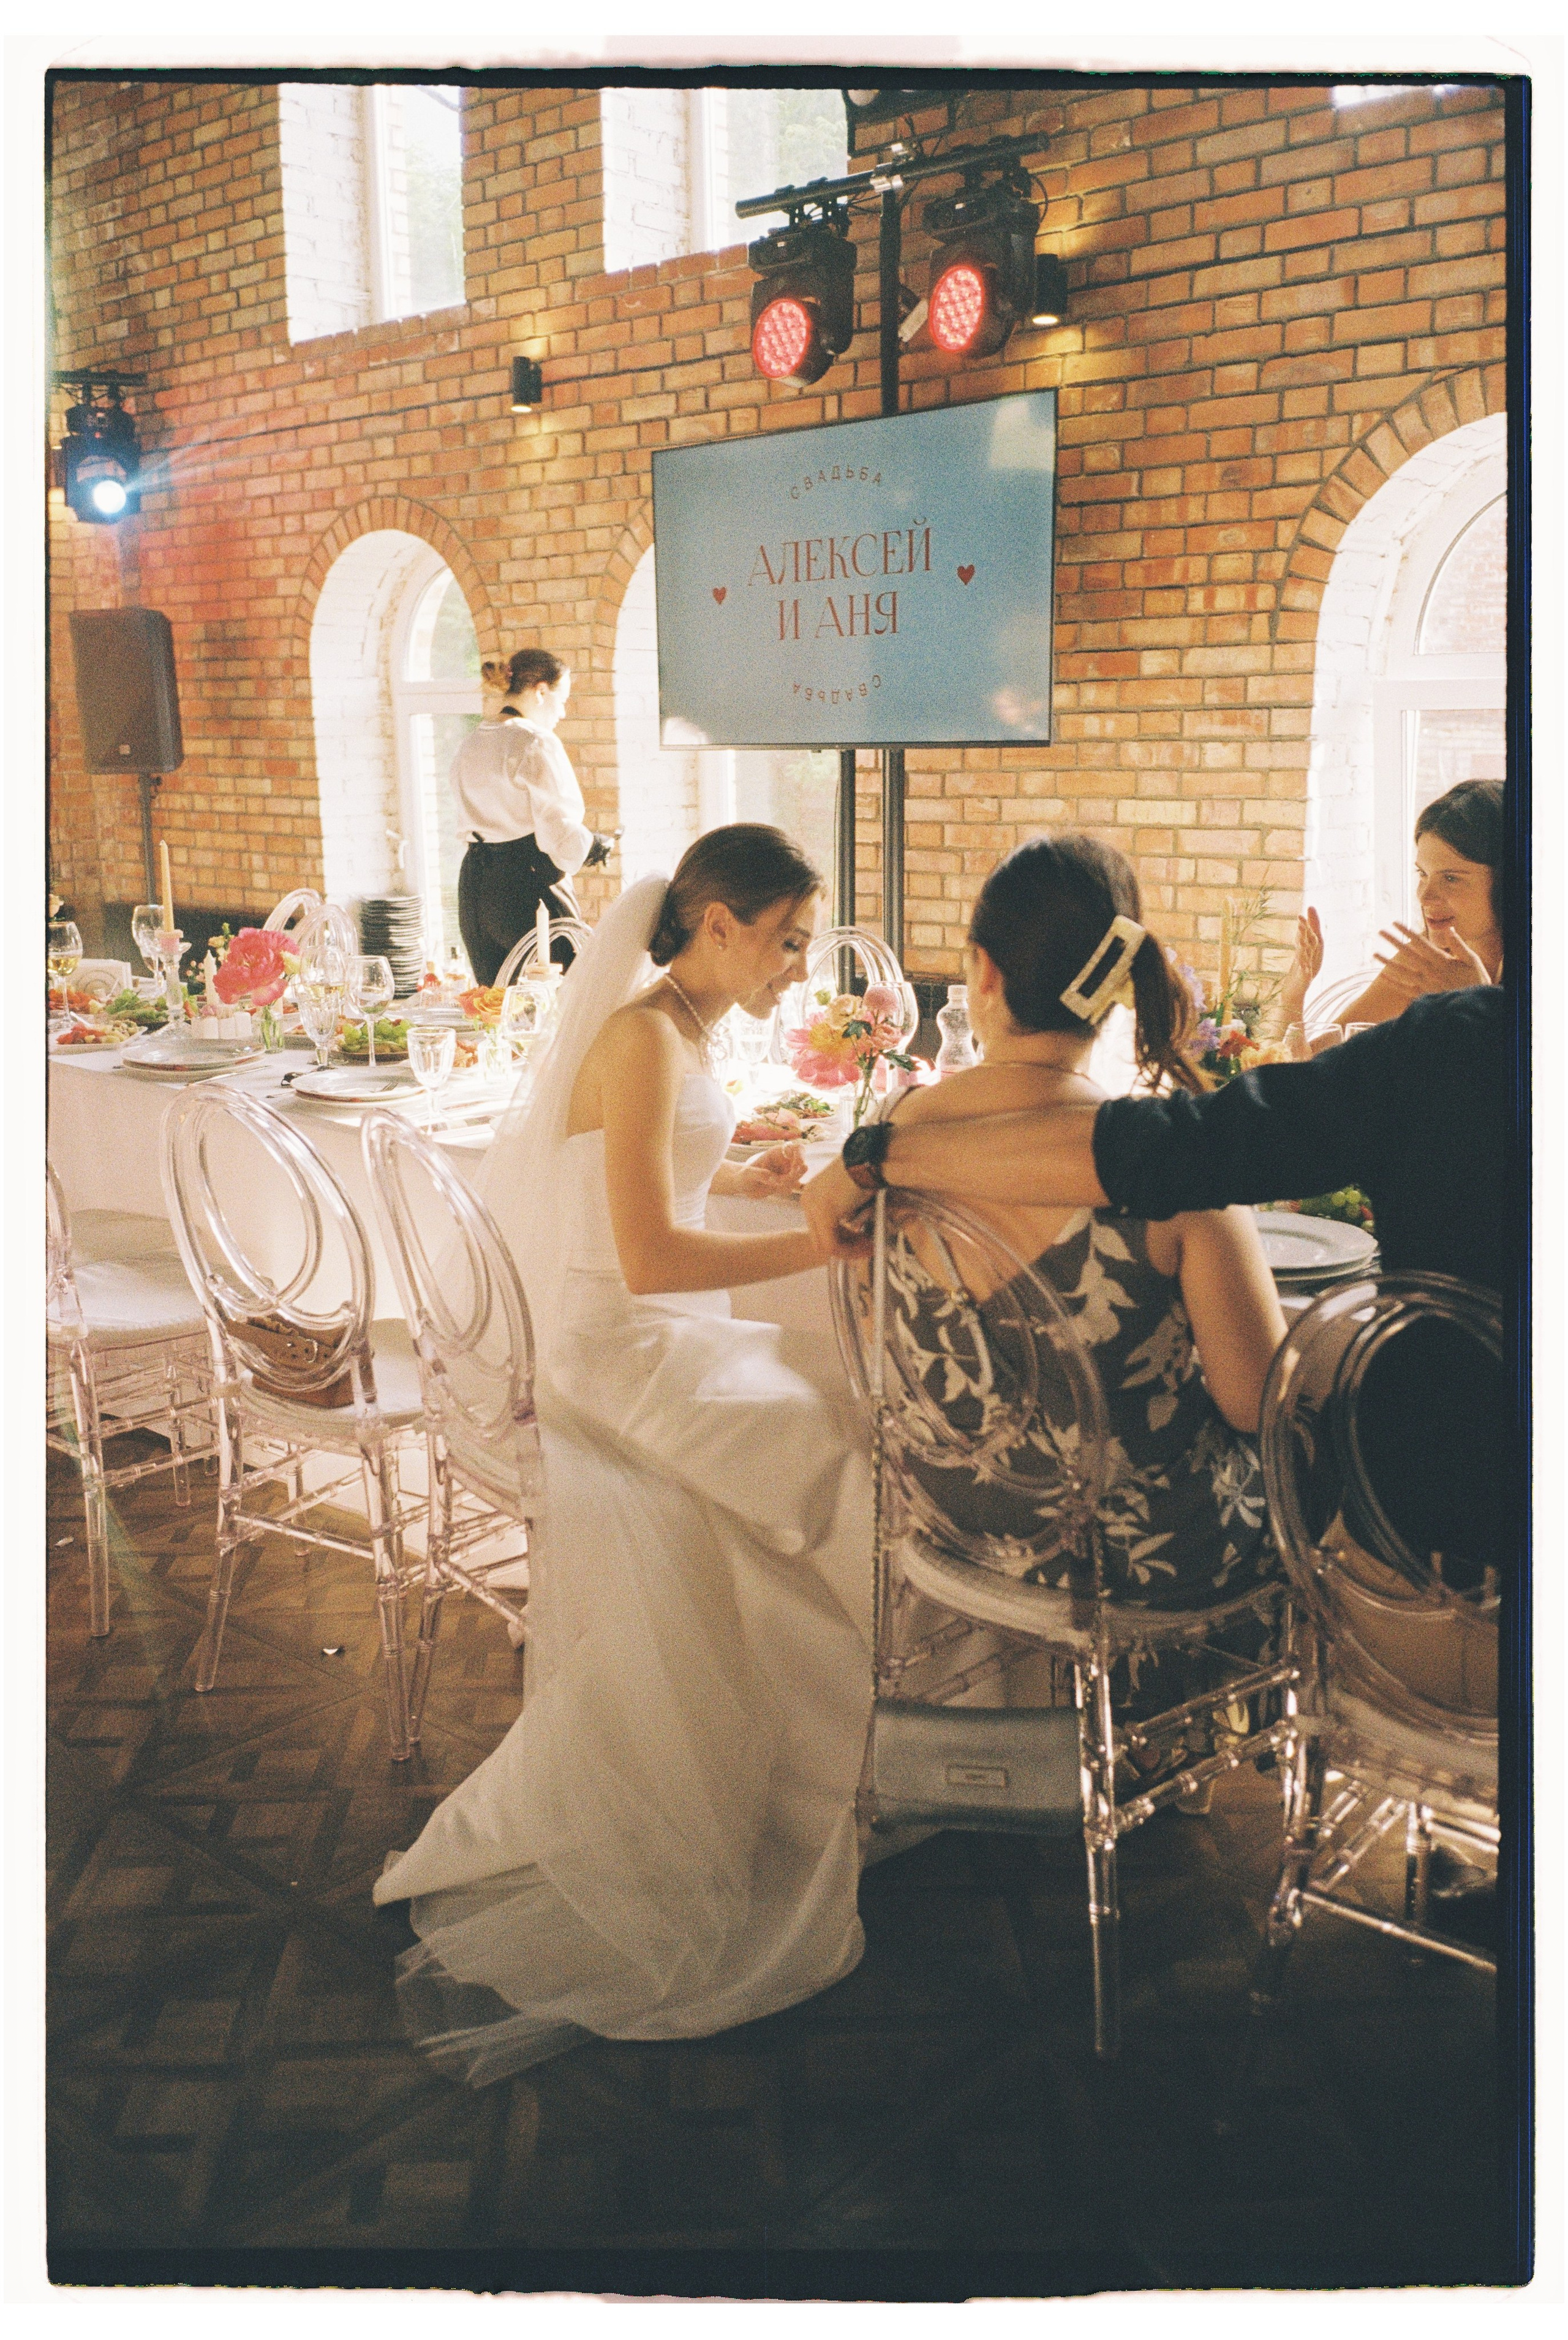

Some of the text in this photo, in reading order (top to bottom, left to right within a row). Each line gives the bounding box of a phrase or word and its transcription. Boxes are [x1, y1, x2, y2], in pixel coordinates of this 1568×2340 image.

[790, 464, 883, 500] СВАДЬБА
[748, 516, 932, 586] АЛЕКСЕЙ
[778, 591, 900, 641] И АНЯ
[793, 674, 882, 704] СВАДЬБА
